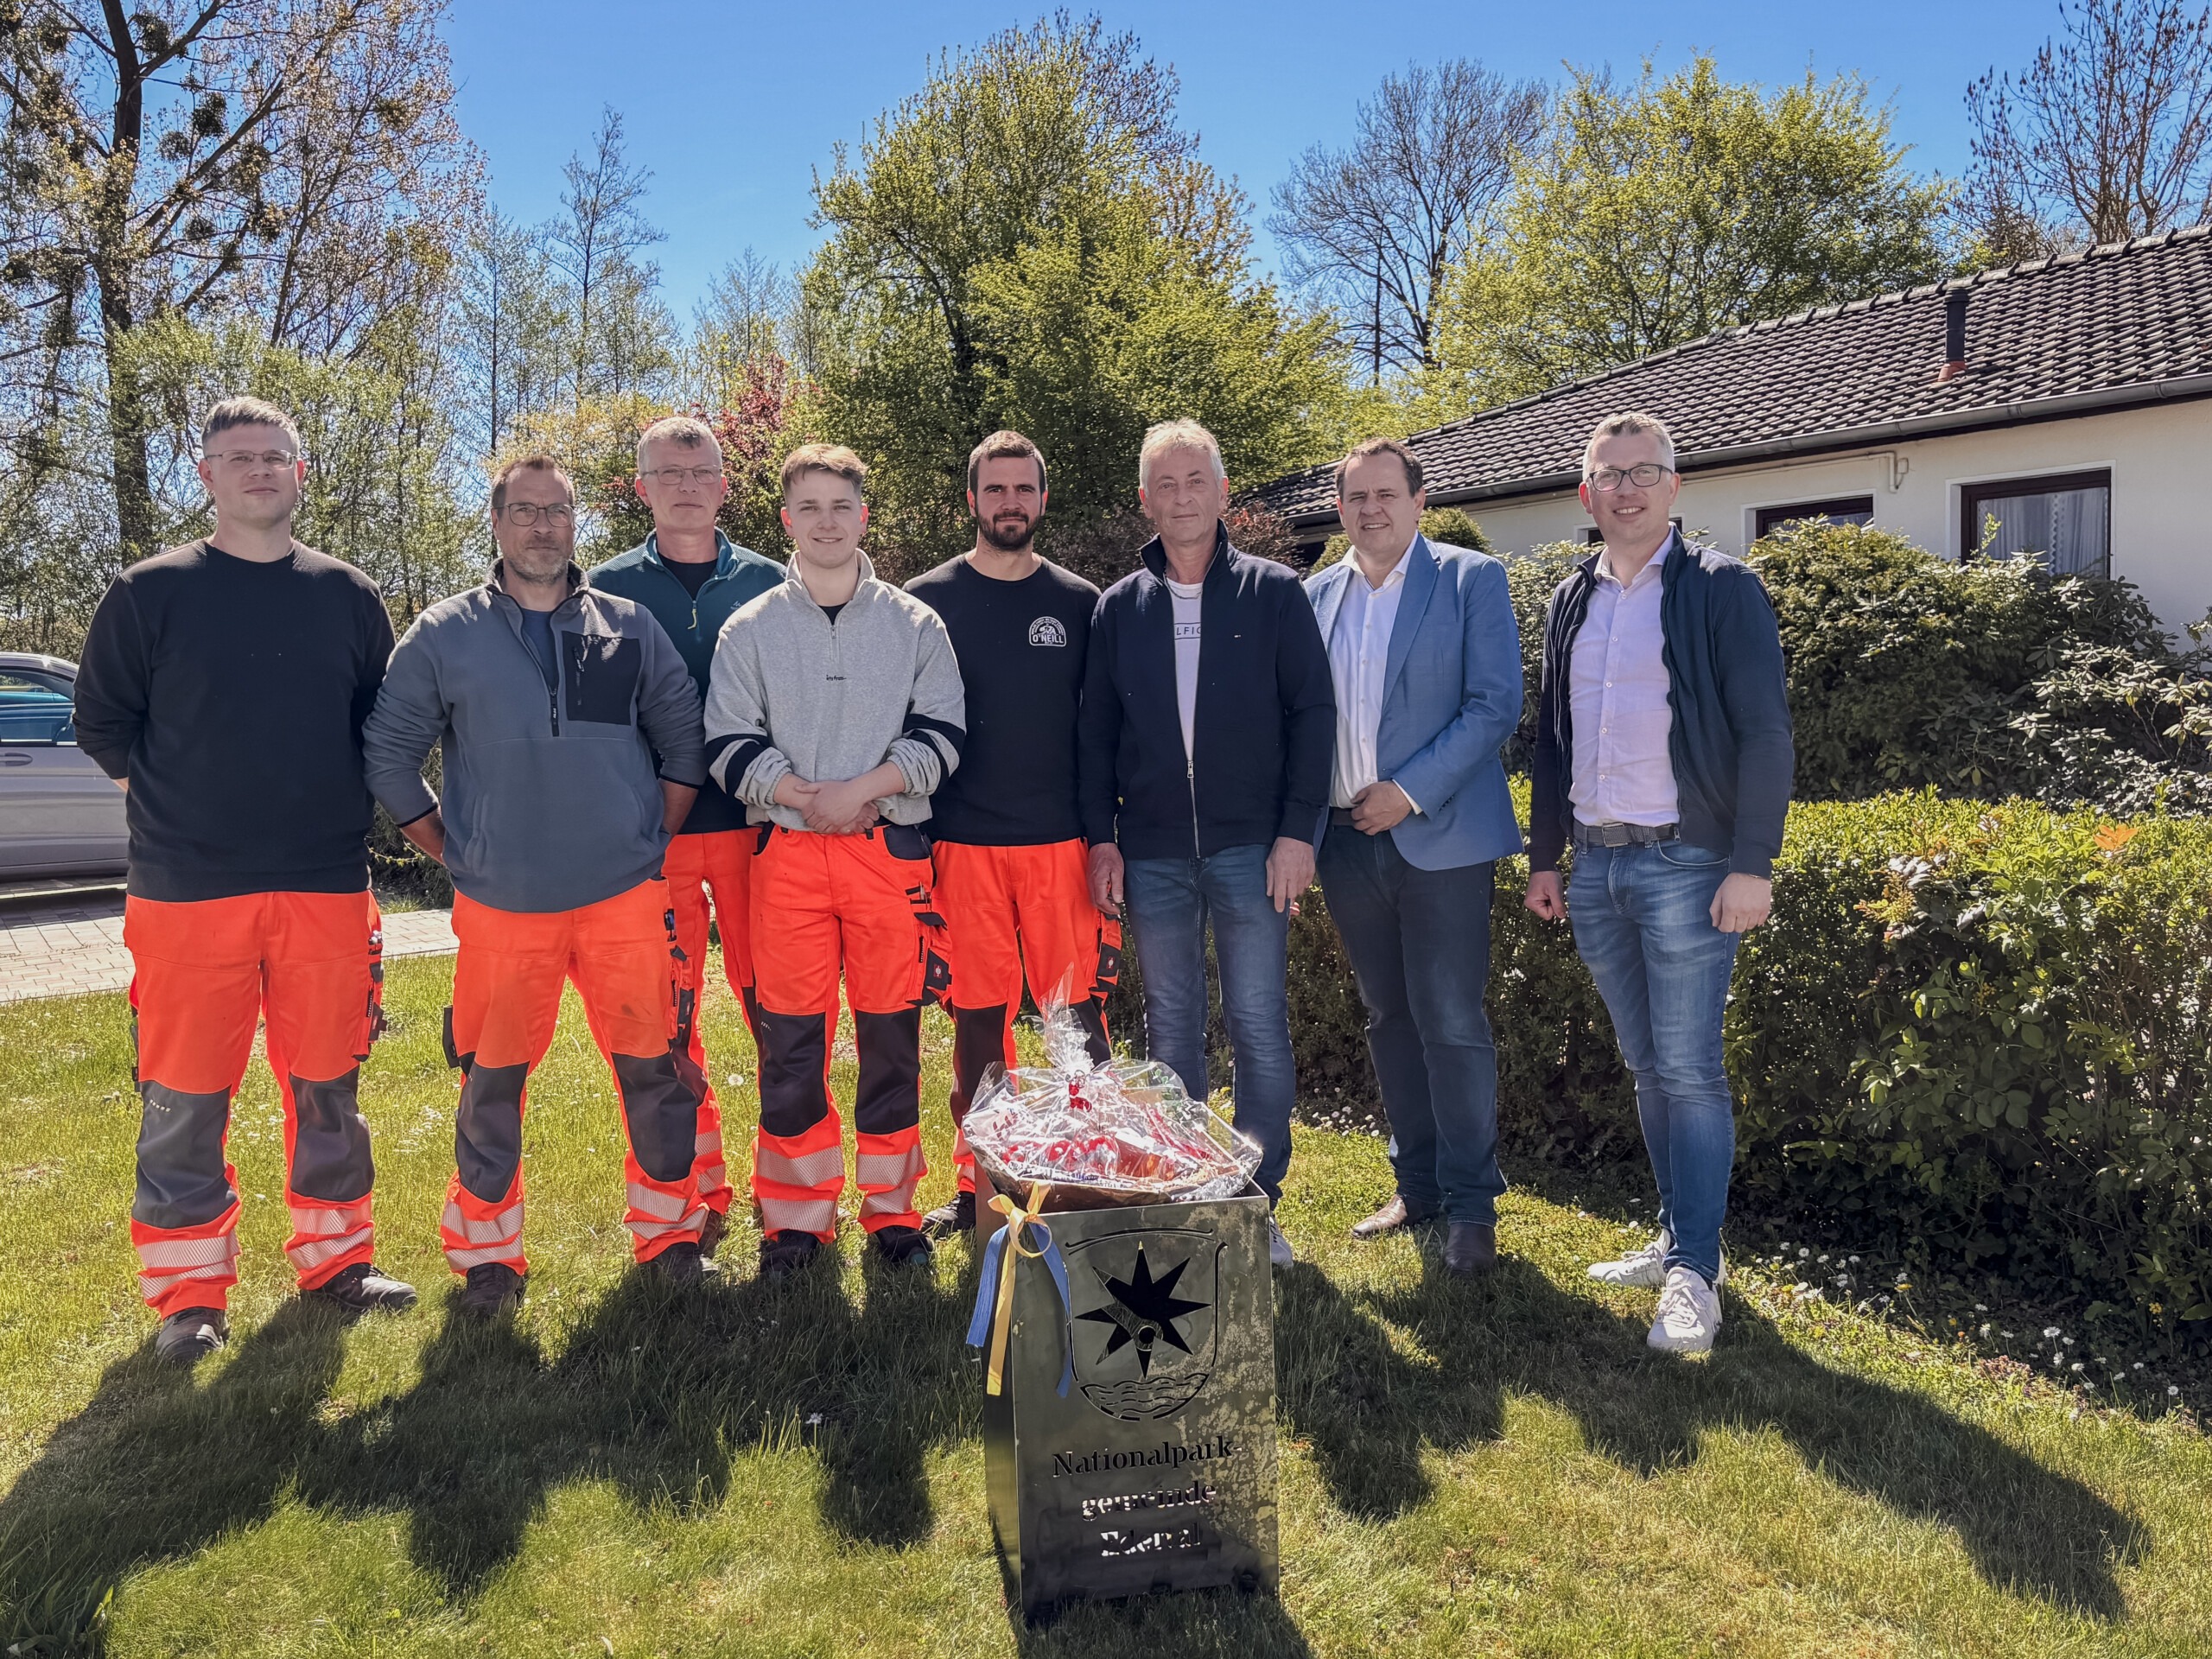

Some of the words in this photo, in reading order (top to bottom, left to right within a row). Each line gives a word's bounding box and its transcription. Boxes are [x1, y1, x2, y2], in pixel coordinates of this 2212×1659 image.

[1033, 634, 1064, 644] O'NEILL
[1052, 1435, 1243, 1478] Nationalpark-
[1082, 1480, 1217, 1522] gemeinde
